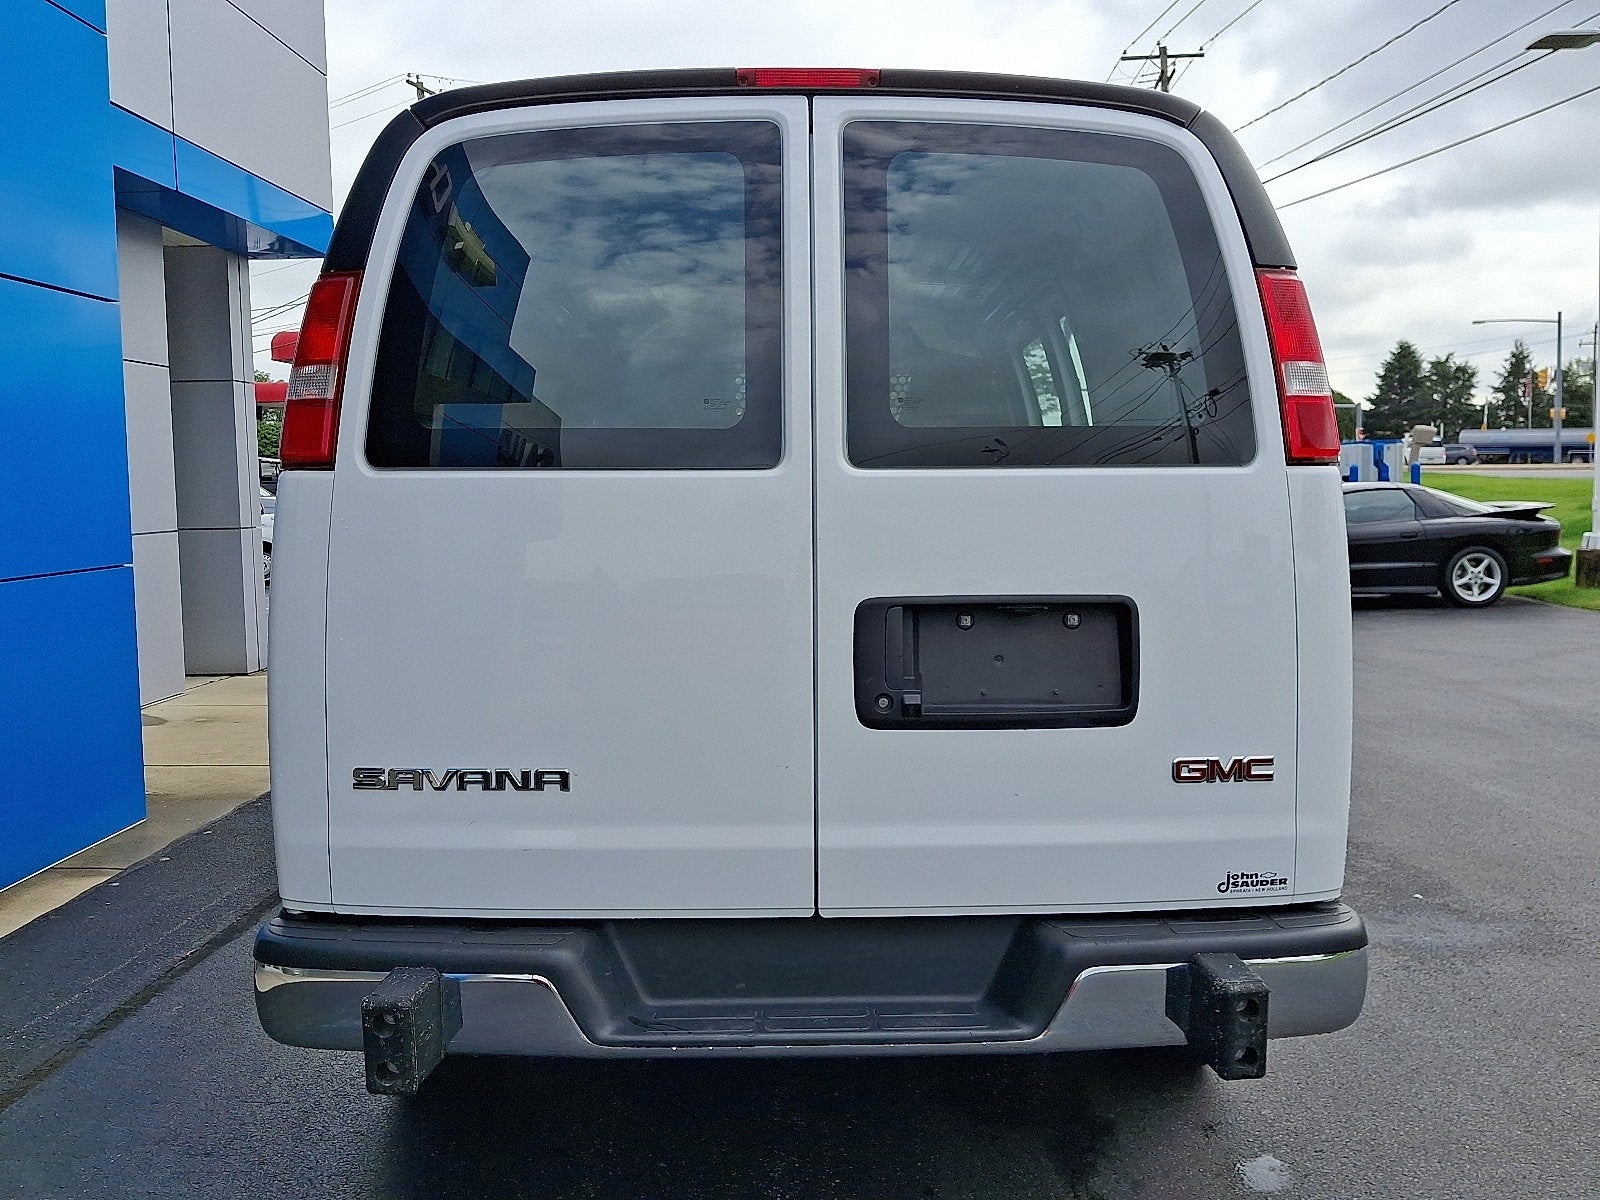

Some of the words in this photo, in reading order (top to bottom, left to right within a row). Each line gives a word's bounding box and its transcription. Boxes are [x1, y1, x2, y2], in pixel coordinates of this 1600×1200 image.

[352, 767, 571, 792] SAVANA
[1172, 755, 1274, 783] GMC
[1217, 871, 1259, 893] john
[1231, 878, 1288, 888] SAUDER
